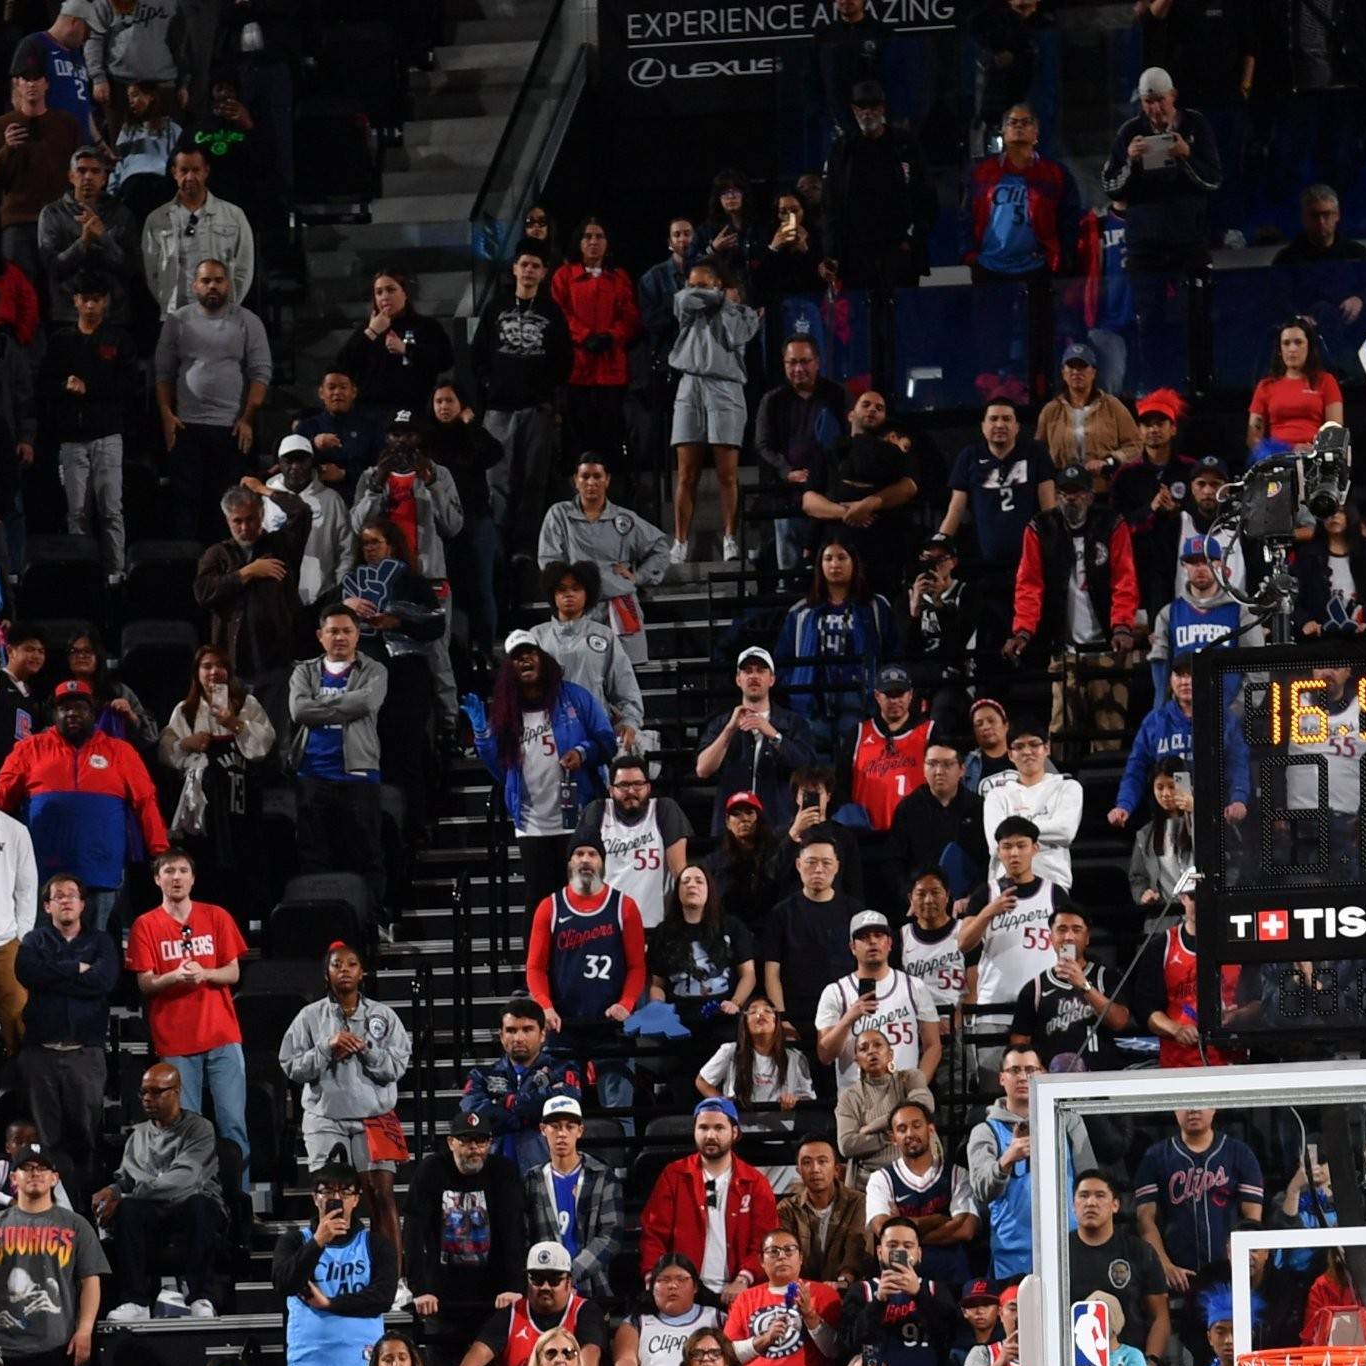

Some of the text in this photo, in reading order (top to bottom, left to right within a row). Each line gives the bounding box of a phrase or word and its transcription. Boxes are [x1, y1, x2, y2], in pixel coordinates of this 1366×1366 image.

[627, 0, 957, 39] EXPERIENCE AAZING
[670, 60, 779, 80] LEXUS
[76, 80, 87, 101] 2
[999, 487, 1015, 512] 2
[894, 775, 906, 797] 1
[604, 832, 656, 857] Clippers
[634, 848, 661, 871] 55
[990, 908, 1050, 932] Clippers
[555, 921, 617, 953] Clippers
[1022, 927, 1051, 950] 55
[582, 953, 613, 981] 32
[906, 950, 962, 977] Clippers
[937, 968, 964, 991] 55
[851, 1005, 911, 1038] Clippers
[886, 1021, 915, 1046] 55
[1168, 1166, 1230, 1206] Clips
[315, 1259, 367, 1285] Clips
[648, 1333, 688, 1355] Clipp
